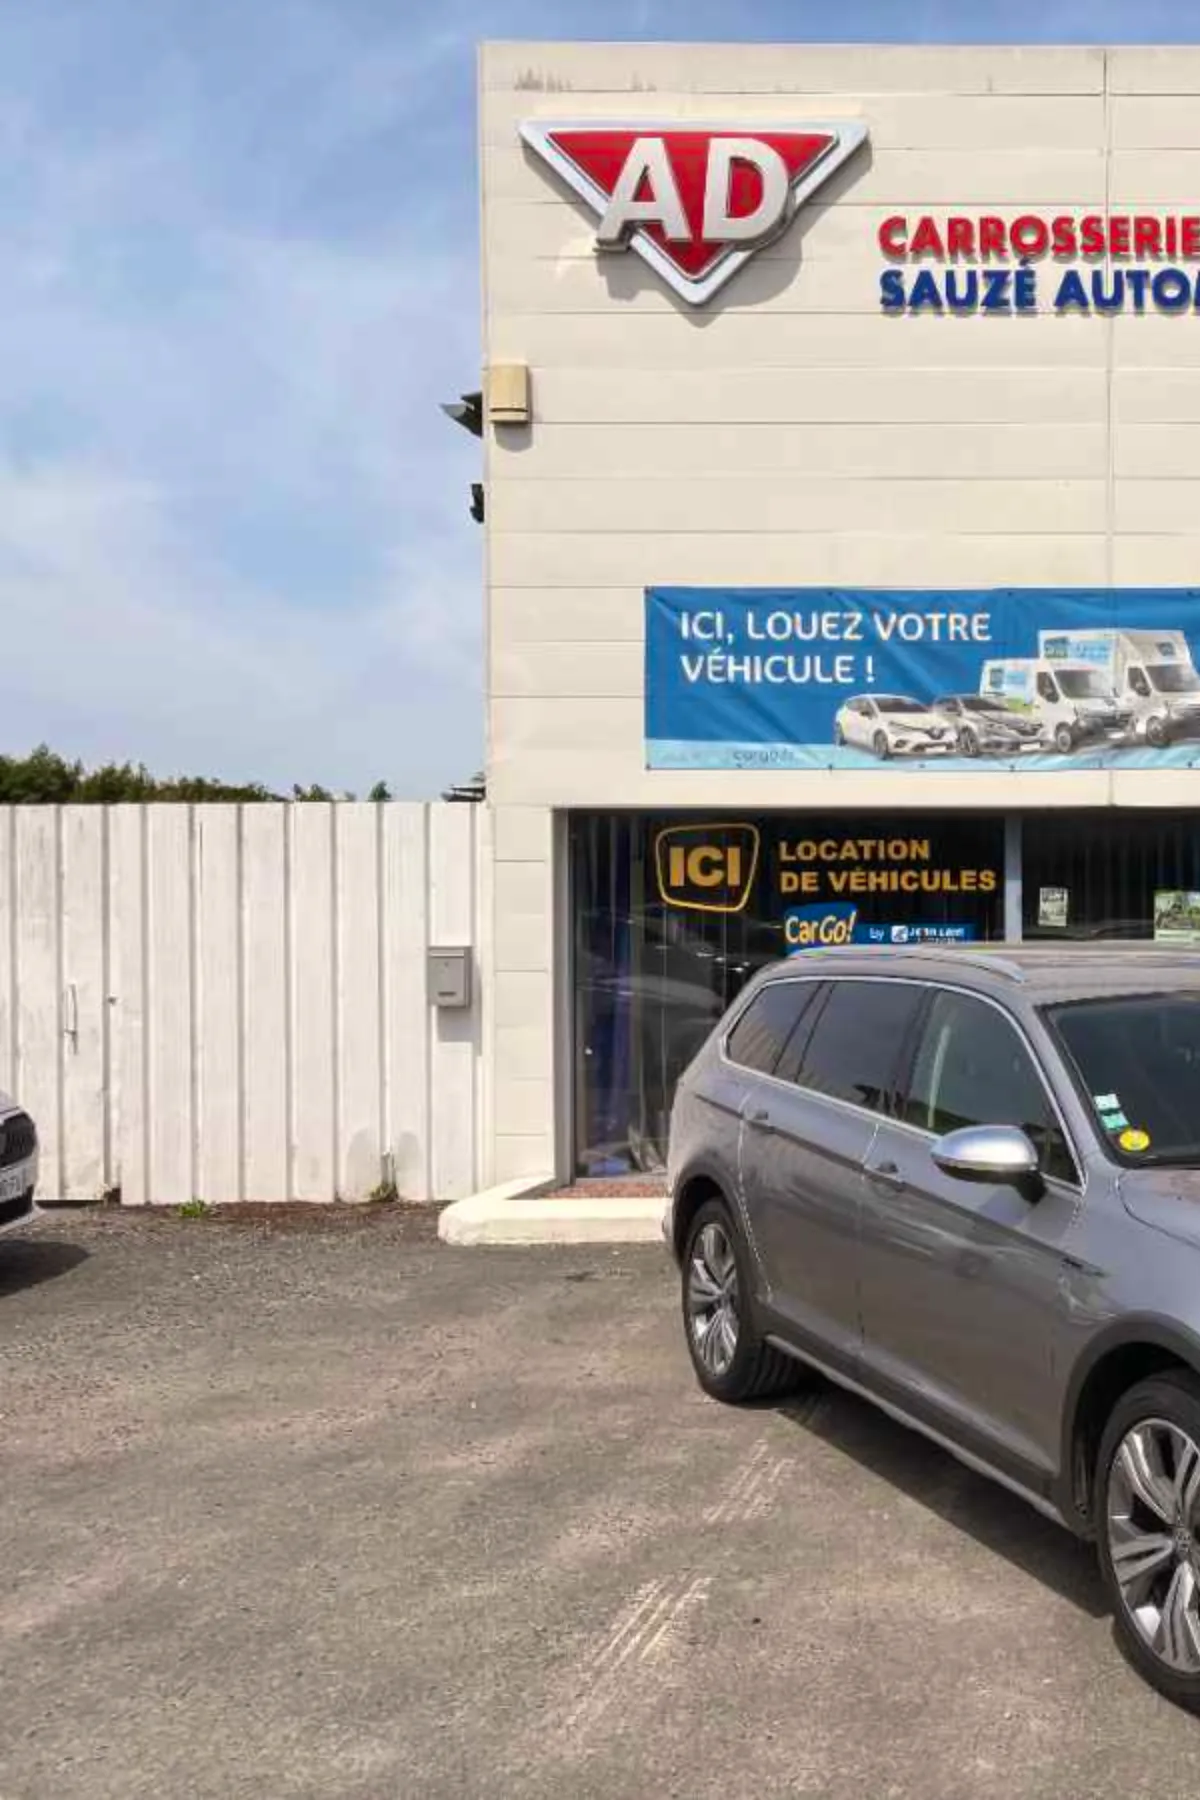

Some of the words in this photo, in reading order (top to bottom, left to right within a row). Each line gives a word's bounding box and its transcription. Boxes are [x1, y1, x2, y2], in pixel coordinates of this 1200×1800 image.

[597, 137, 793, 246] AD
[879, 257, 1039, 314] SAUZÉ
[680, 610, 734, 645] ICI,
[746, 611, 864, 641] LOUEZ
[873, 612, 993, 642] VOTRE
[680, 648, 856, 684] VÉHICULE
[669, 846, 741, 887] ICI
[779, 839, 930, 861] LOCATION
[780, 871, 819, 893] DE
[828, 867, 997, 892] VÉHICULES
[784, 910, 858, 945] CarGo!
